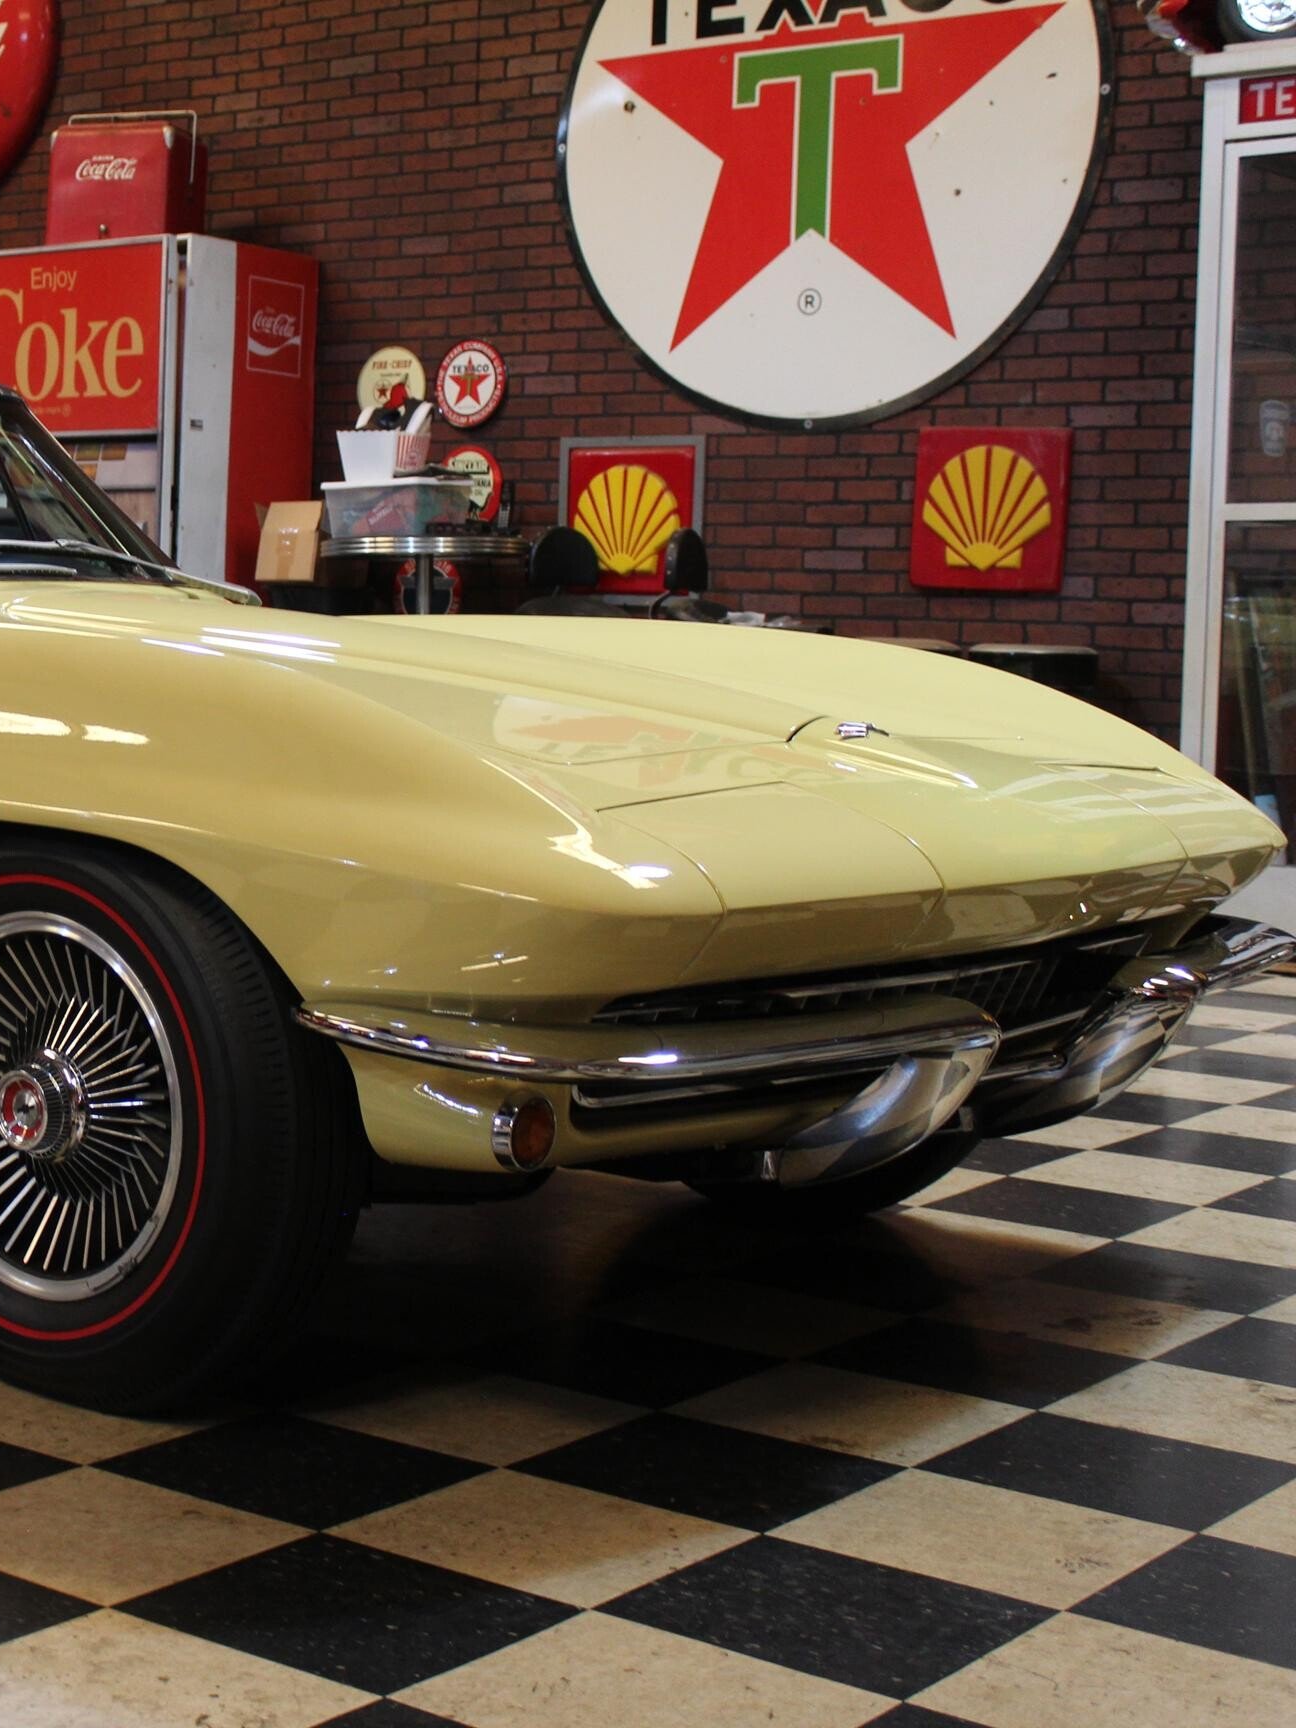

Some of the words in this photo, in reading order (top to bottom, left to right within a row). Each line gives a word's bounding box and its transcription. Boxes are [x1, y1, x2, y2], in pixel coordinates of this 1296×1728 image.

[1248, 80, 1296, 118] TE
[75, 157, 137, 181] Coca-Cola
[30, 266, 77, 292] Enjoy
